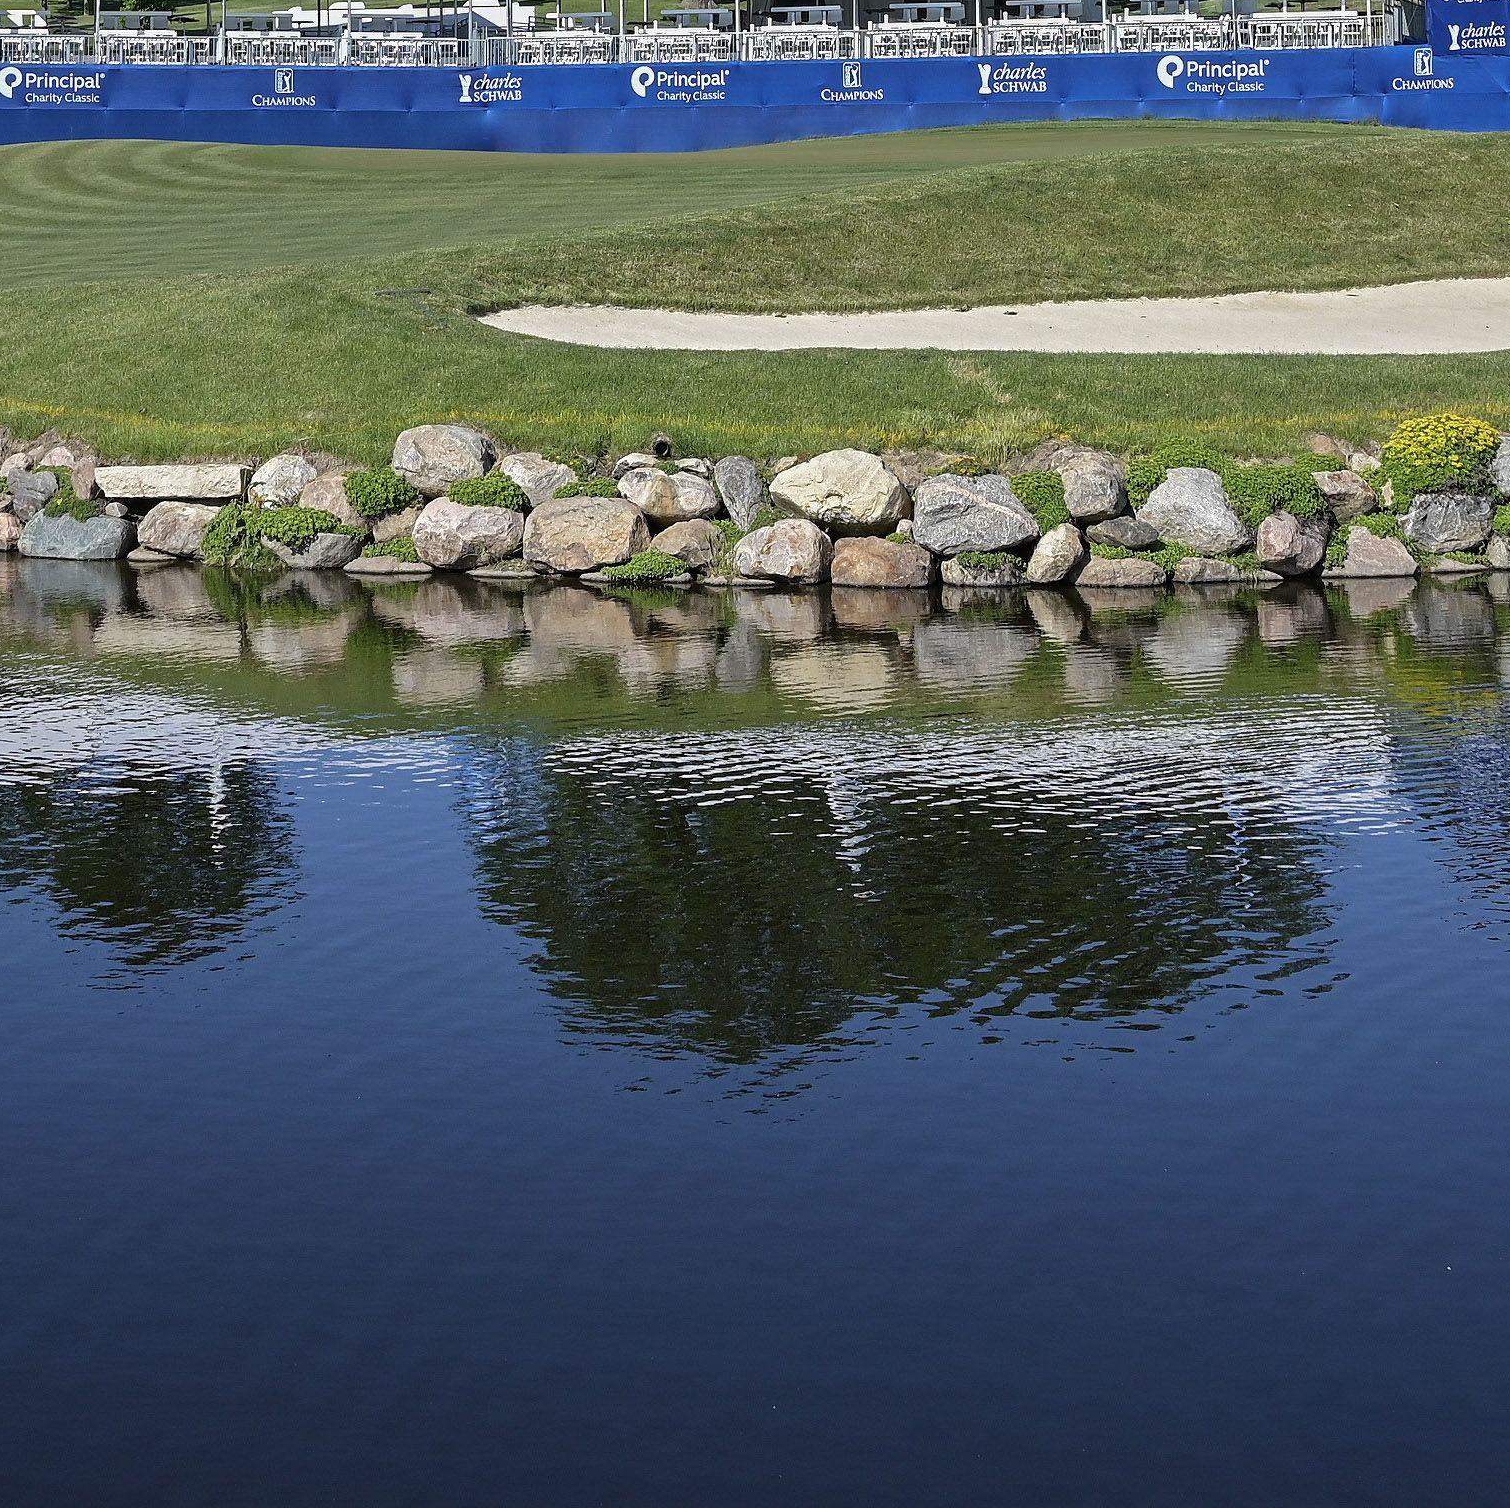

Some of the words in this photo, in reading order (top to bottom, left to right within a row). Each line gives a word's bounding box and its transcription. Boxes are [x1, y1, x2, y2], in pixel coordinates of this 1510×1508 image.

[1460, 20, 1506, 39] charles
[1460, 37, 1507, 51] SCHWAB
[993, 61, 1047, 80] charles
[473, 72, 523, 89] charles
[992, 81, 1048, 93] SCHWAB
[1186, 81, 1226, 96] Charity
[1227, 78, 1265, 92] Classic
[1392, 77, 1454, 91] CHAMPIONS
[25, 92, 63, 105] Charity
[64, 90, 100, 103] Classic
[251, 94, 316, 107] CHAMPIONS
[473, 90, 522, 103] SCHWAB
[656, 90, 691, 103] Charity
[692, 90, 726, 101] Classic
[820, 88, 884, 102] CHAMPIONS
